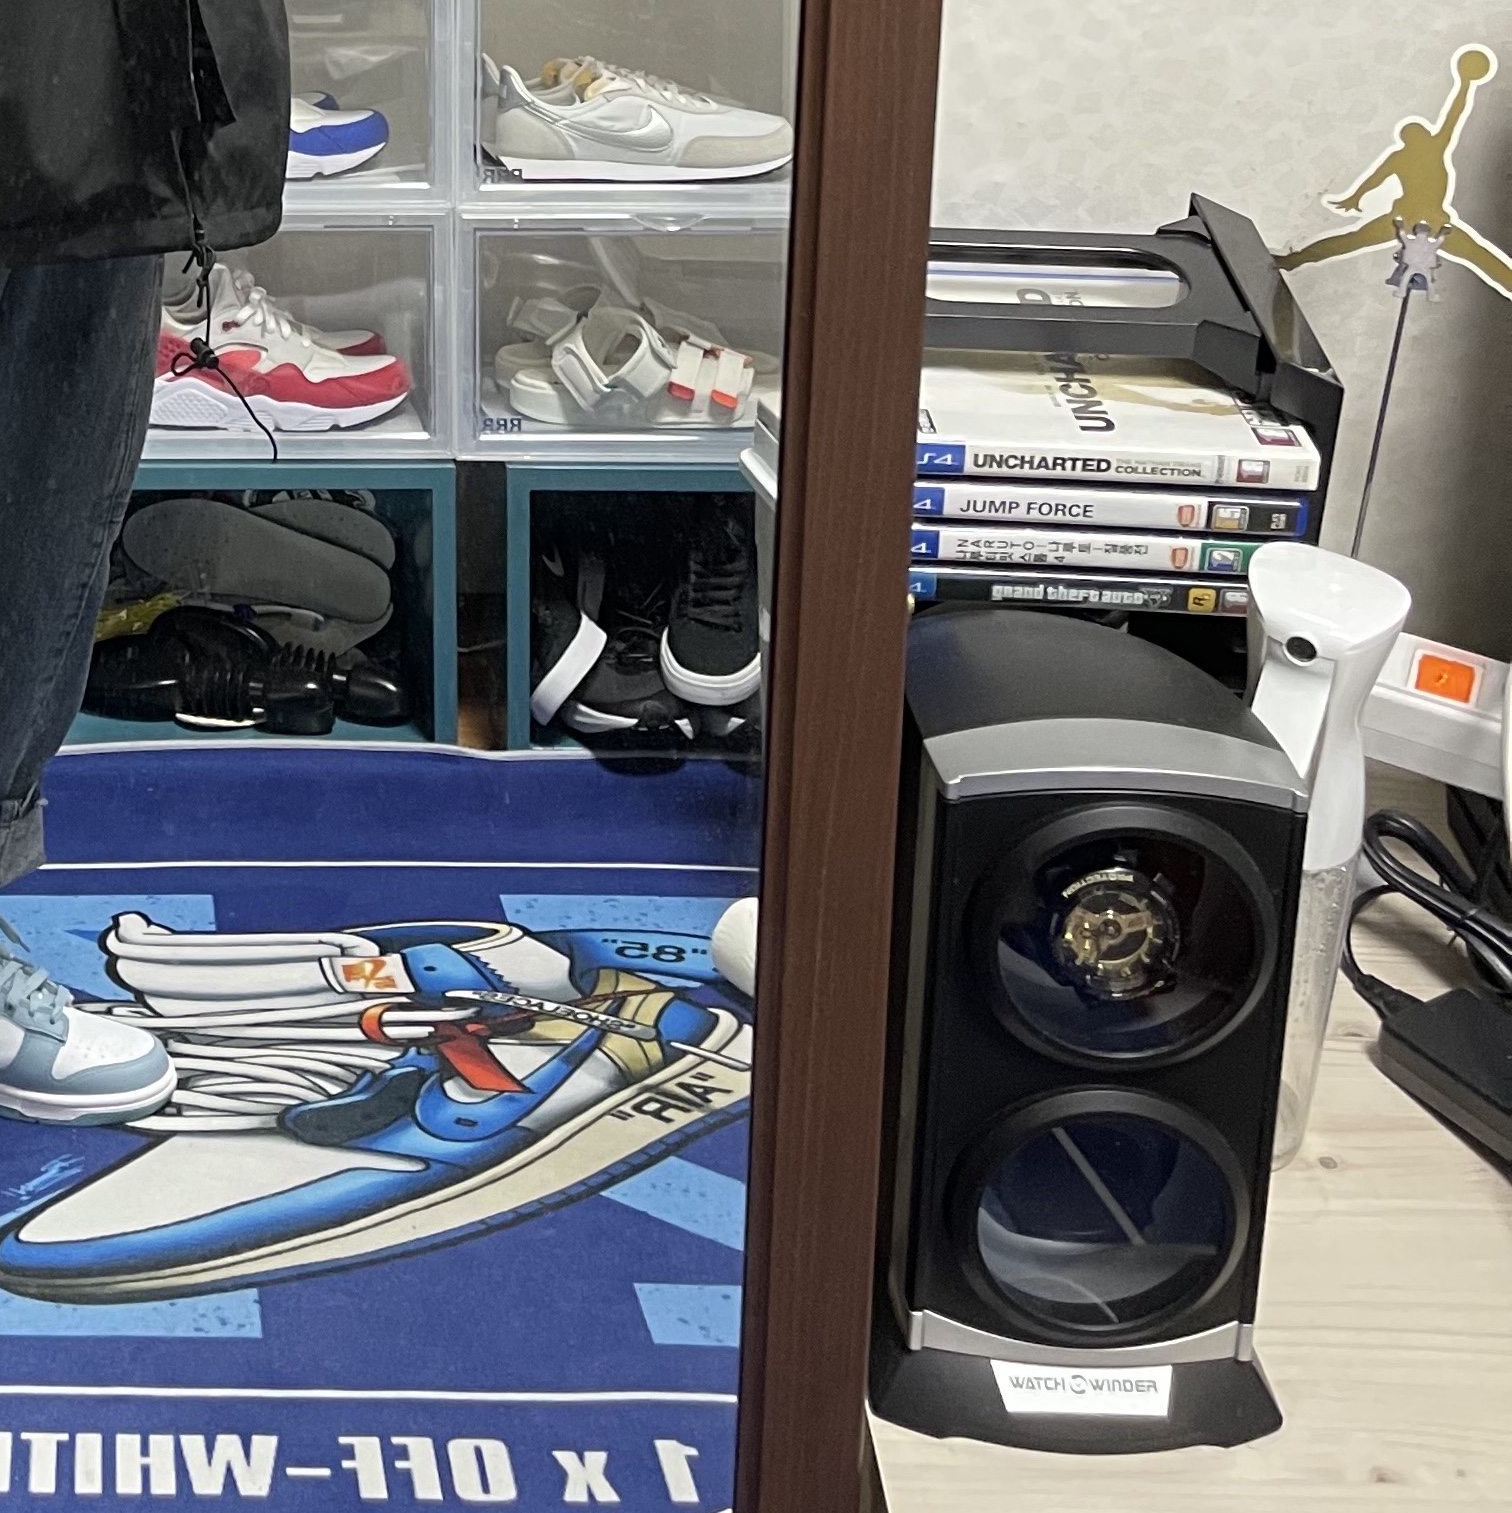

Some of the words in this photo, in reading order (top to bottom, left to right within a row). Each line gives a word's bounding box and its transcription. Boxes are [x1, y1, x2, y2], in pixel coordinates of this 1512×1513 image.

[973, 453, 1112, 473] UNCHARTED
[1115, 465, 1202, 478] COLLECTION
[960, 500, 1020, 514] JUMP
[1026, 501, 1095, 518] FORCE
[991, 584, 1045, 601] grand
[1046, 585, 1100, 602] theft
[1100, 590, 1144, 604] auto
[1009, 1375, 1066, 1391] WATCH
[1088, 1378, 1159, 1394] WINDER
